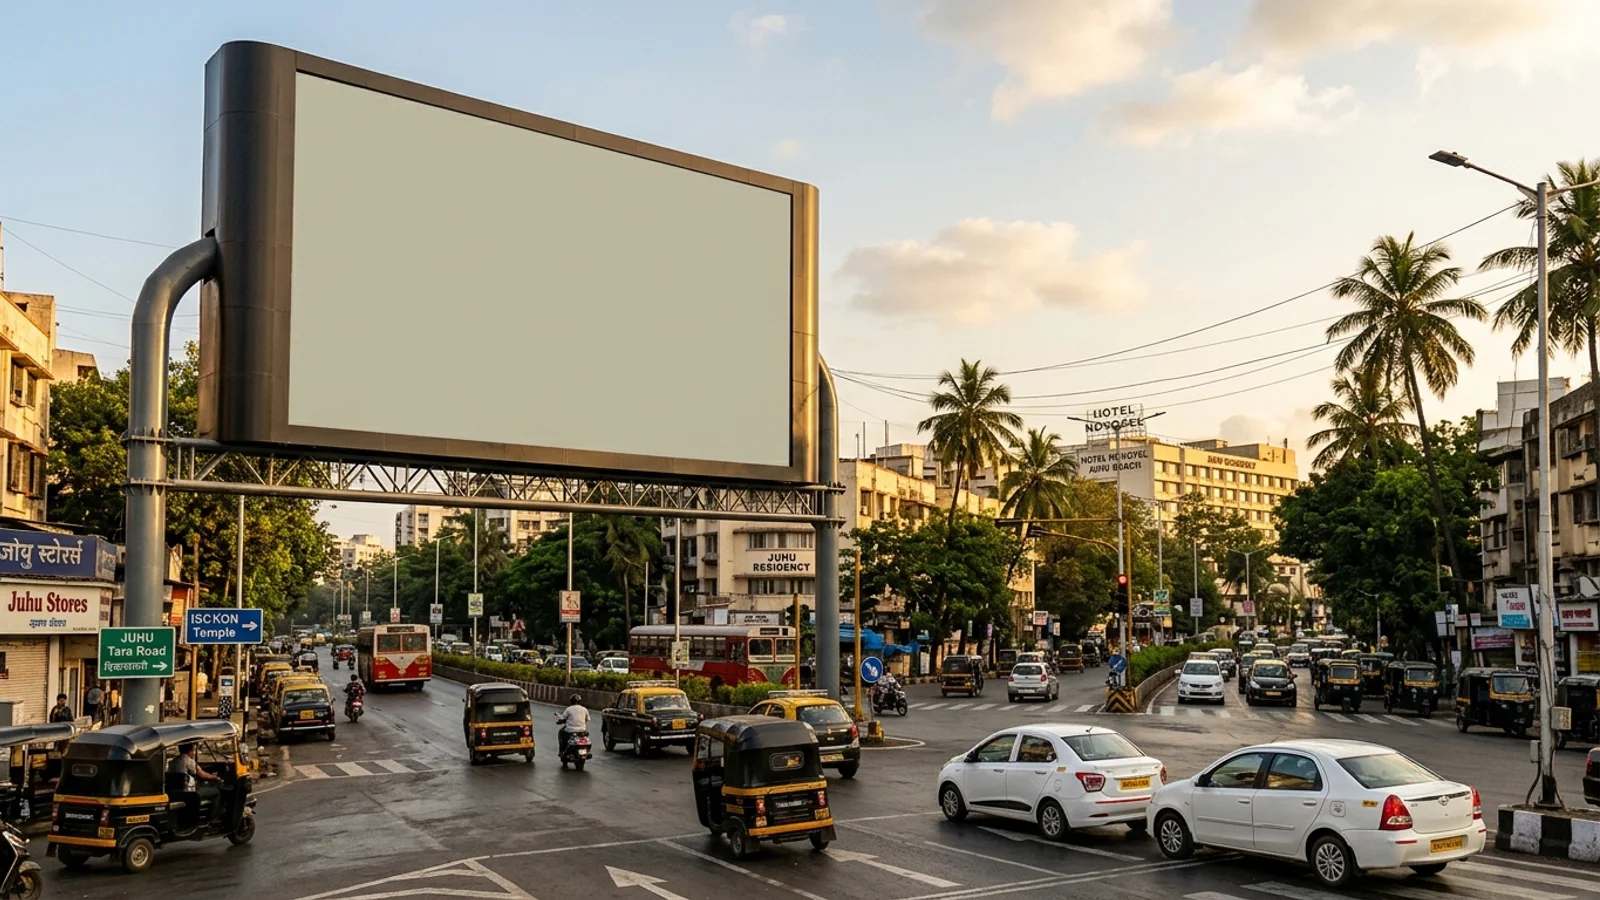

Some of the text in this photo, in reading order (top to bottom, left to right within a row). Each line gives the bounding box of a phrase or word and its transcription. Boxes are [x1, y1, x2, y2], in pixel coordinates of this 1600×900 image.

[767, 553, 796, 562] JUHU
[8, 591, 43, 612] Juhu
[46, 591, 88, 613] Stores
[190, 613, 239, 625] ISCKON
[120, 632, 154, 644] JUHU
[193, 627, 236, 640] Temple
[107, 645, 167, 657] Tara Road
